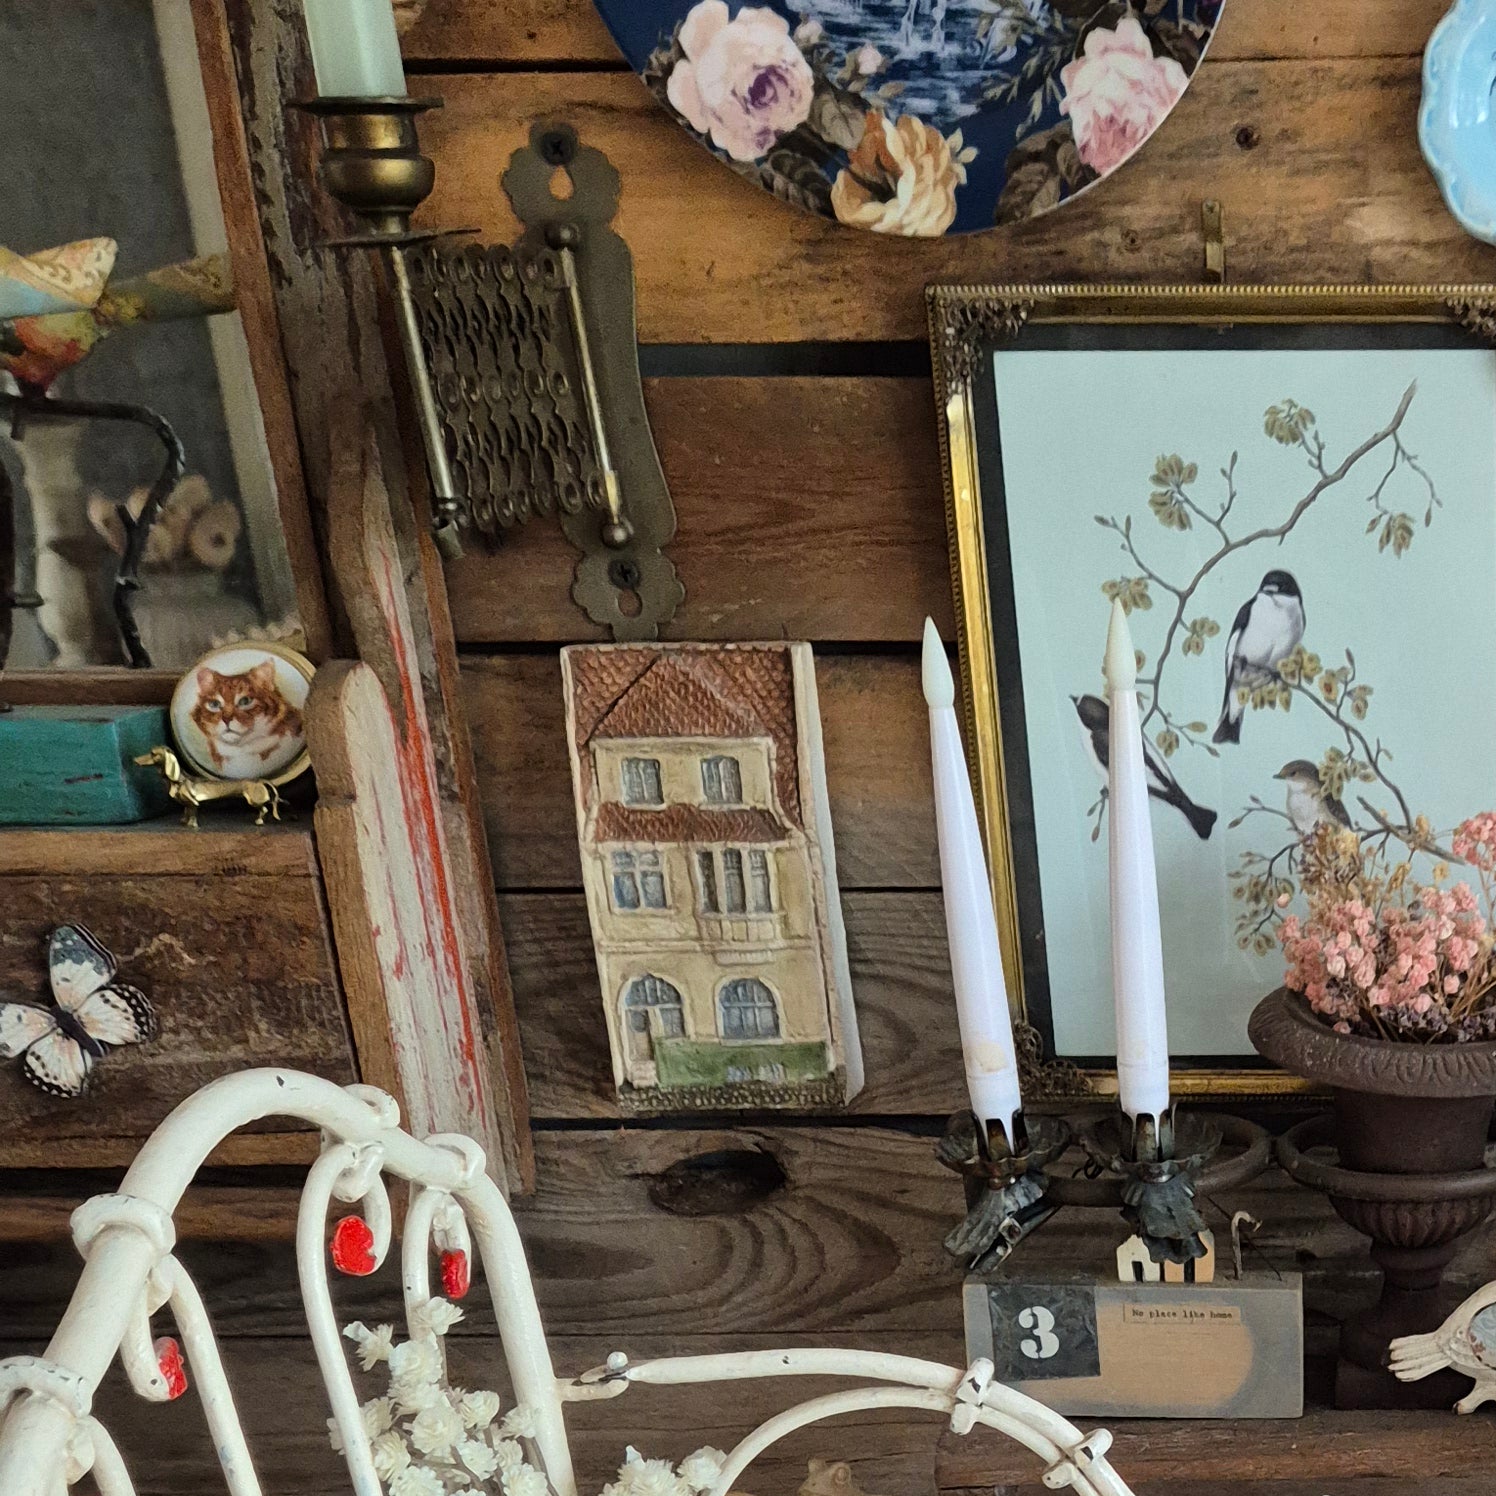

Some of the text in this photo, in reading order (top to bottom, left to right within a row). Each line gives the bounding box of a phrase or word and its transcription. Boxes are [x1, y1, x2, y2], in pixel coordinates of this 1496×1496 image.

[1132, 1308, 1233, 1319] No place like home
[1018, 1305, 1060, 1359] 3
